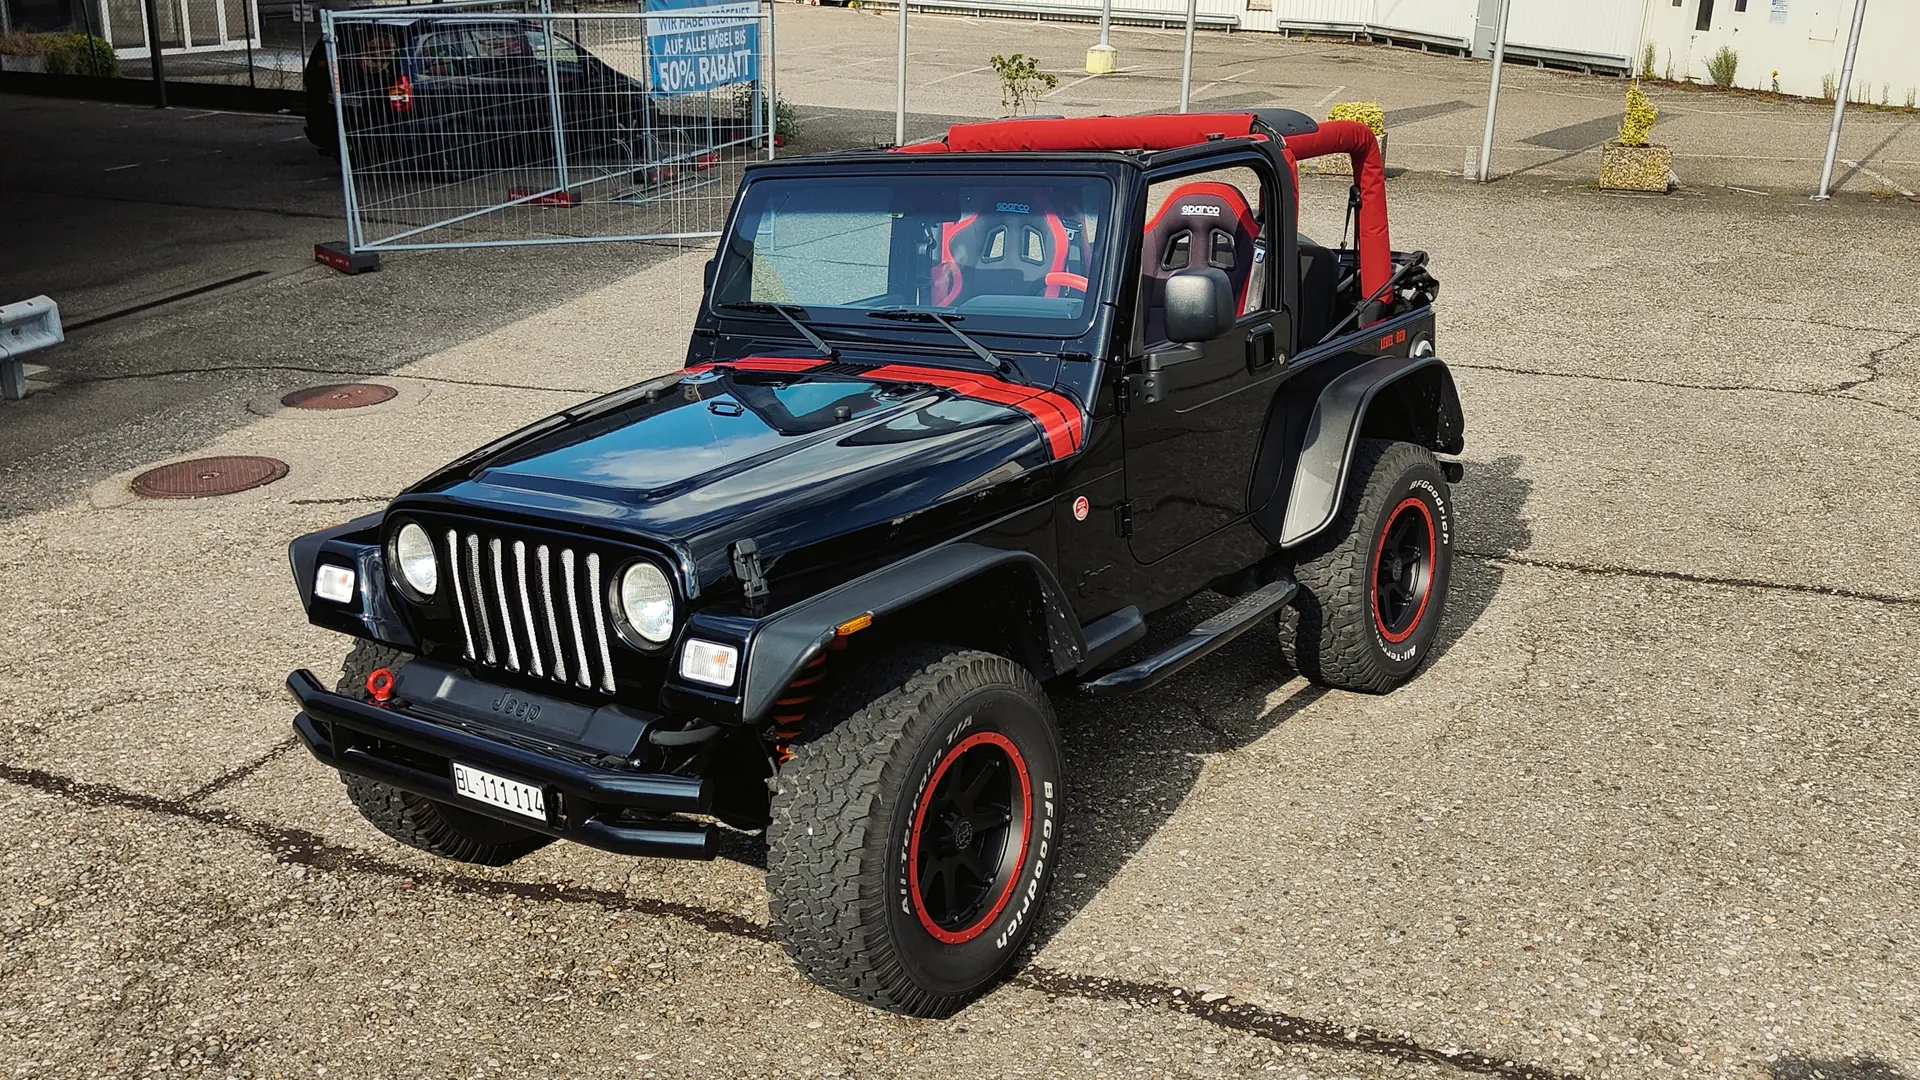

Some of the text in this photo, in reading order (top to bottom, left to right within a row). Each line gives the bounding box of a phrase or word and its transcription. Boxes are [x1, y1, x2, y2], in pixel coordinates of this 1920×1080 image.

[659, 17, 678, 31] WIR
[680, 12, 709, 29] HABEN
[664, 29, 747, 56] AUF ALLE MÖBEL BIS
[660, 49, 752, 92] 50% RABATT
[1408, 479, 1449, 545] BFGoodrich
[492, 691, 542, 723] Jeep
[900, 715, 974, 916] All-Terrain T/A
[996, 780, 1055, 950] BFGoodrich
